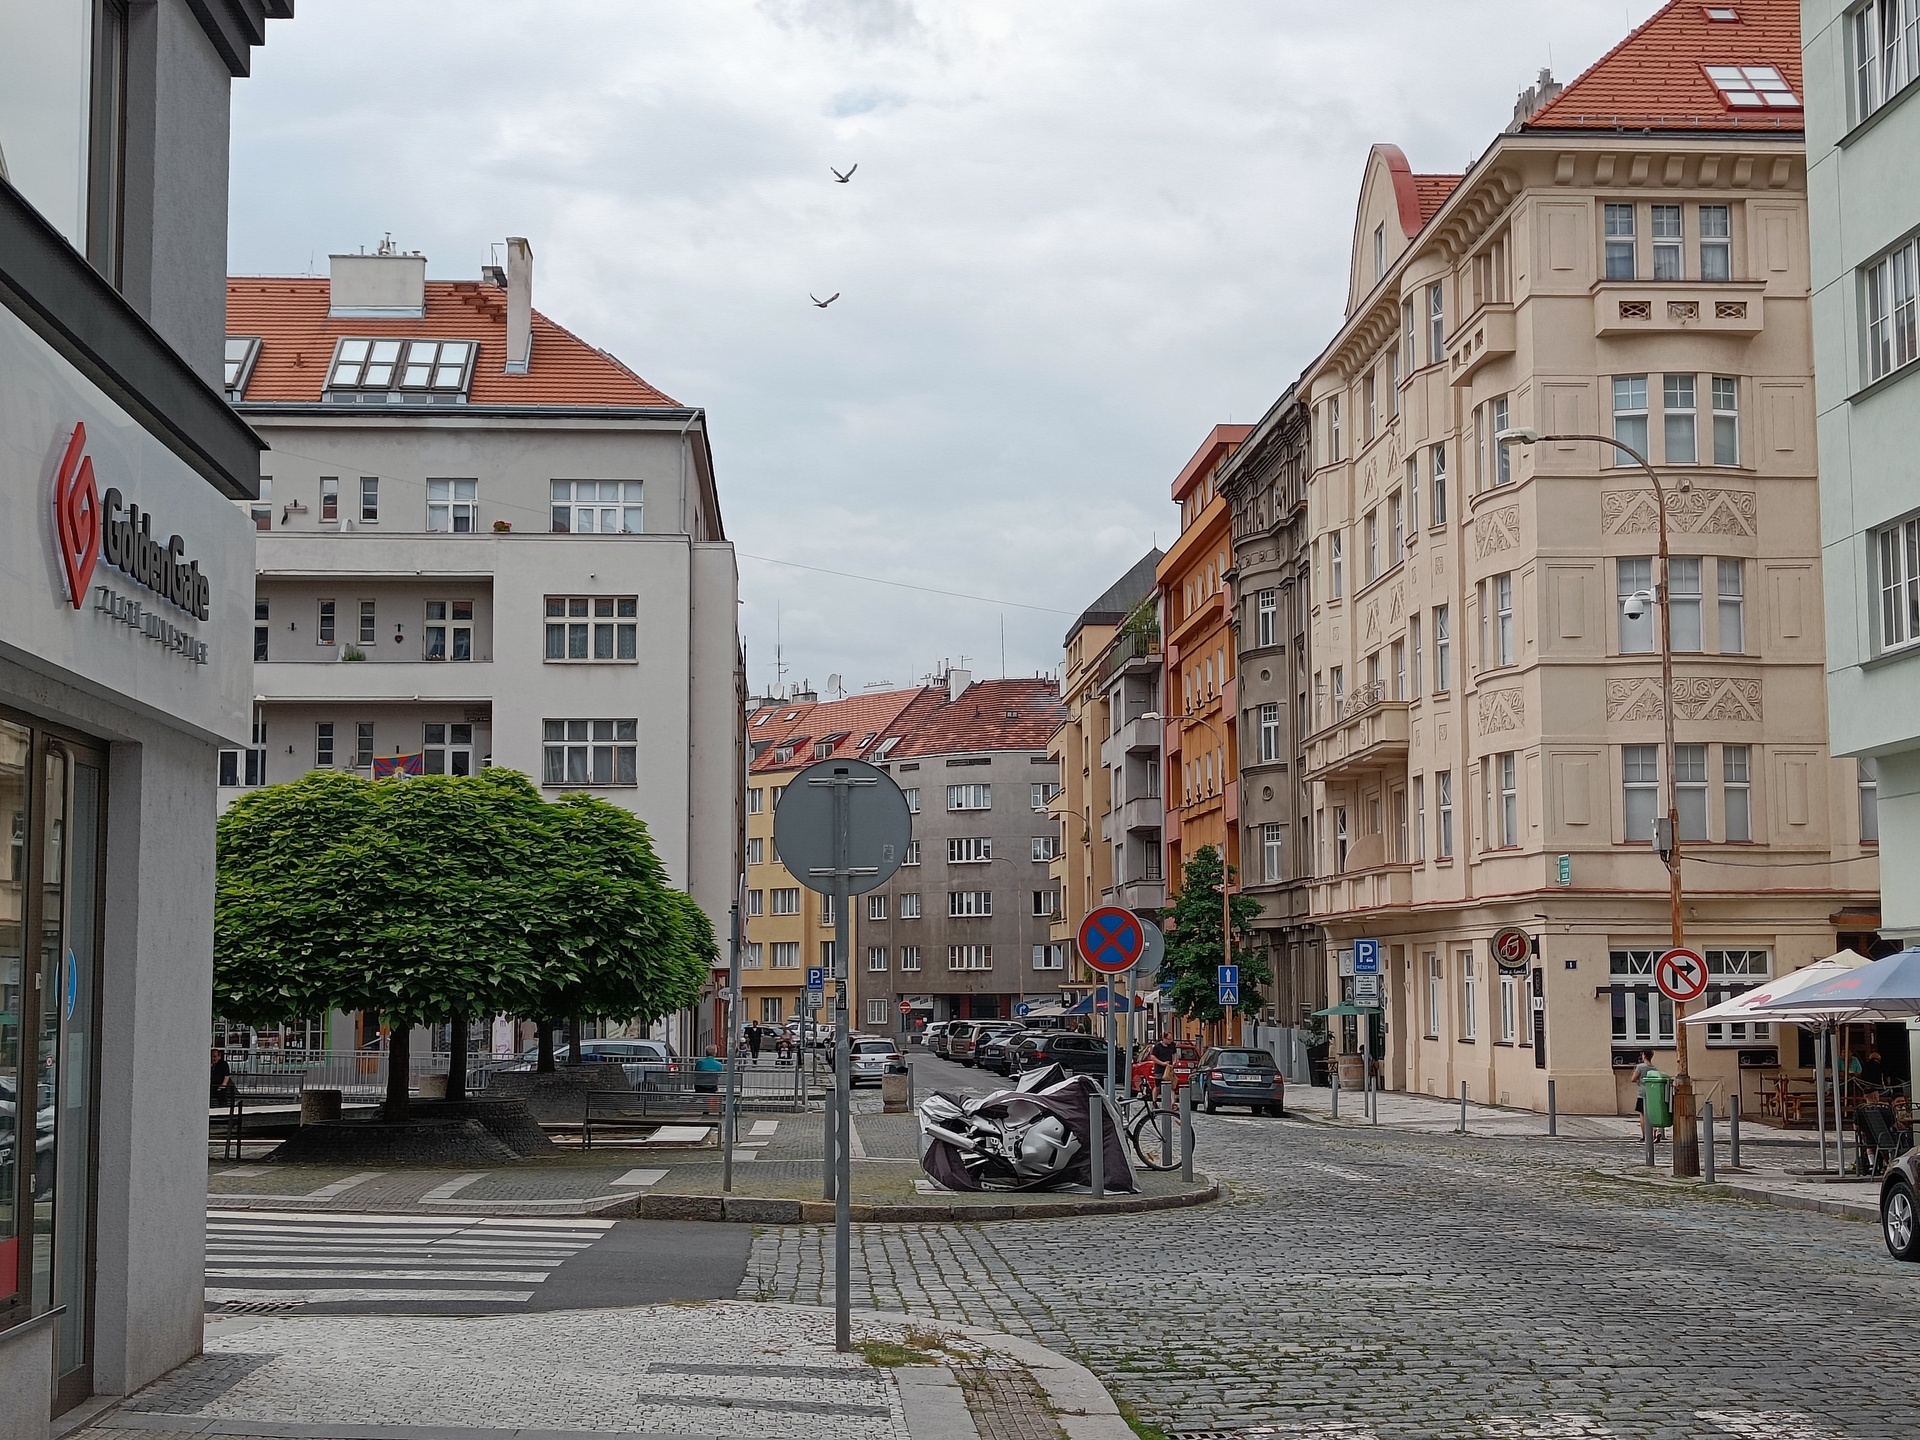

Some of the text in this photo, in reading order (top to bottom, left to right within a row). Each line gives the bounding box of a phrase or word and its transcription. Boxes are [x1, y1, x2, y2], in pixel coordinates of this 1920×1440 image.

[103, 488, 210, 621] GoldenGate
[140, 612, 208, 664] INVESTICE
[1359, 943, 1373, 963] P
[810, 969, 820, 984] P
